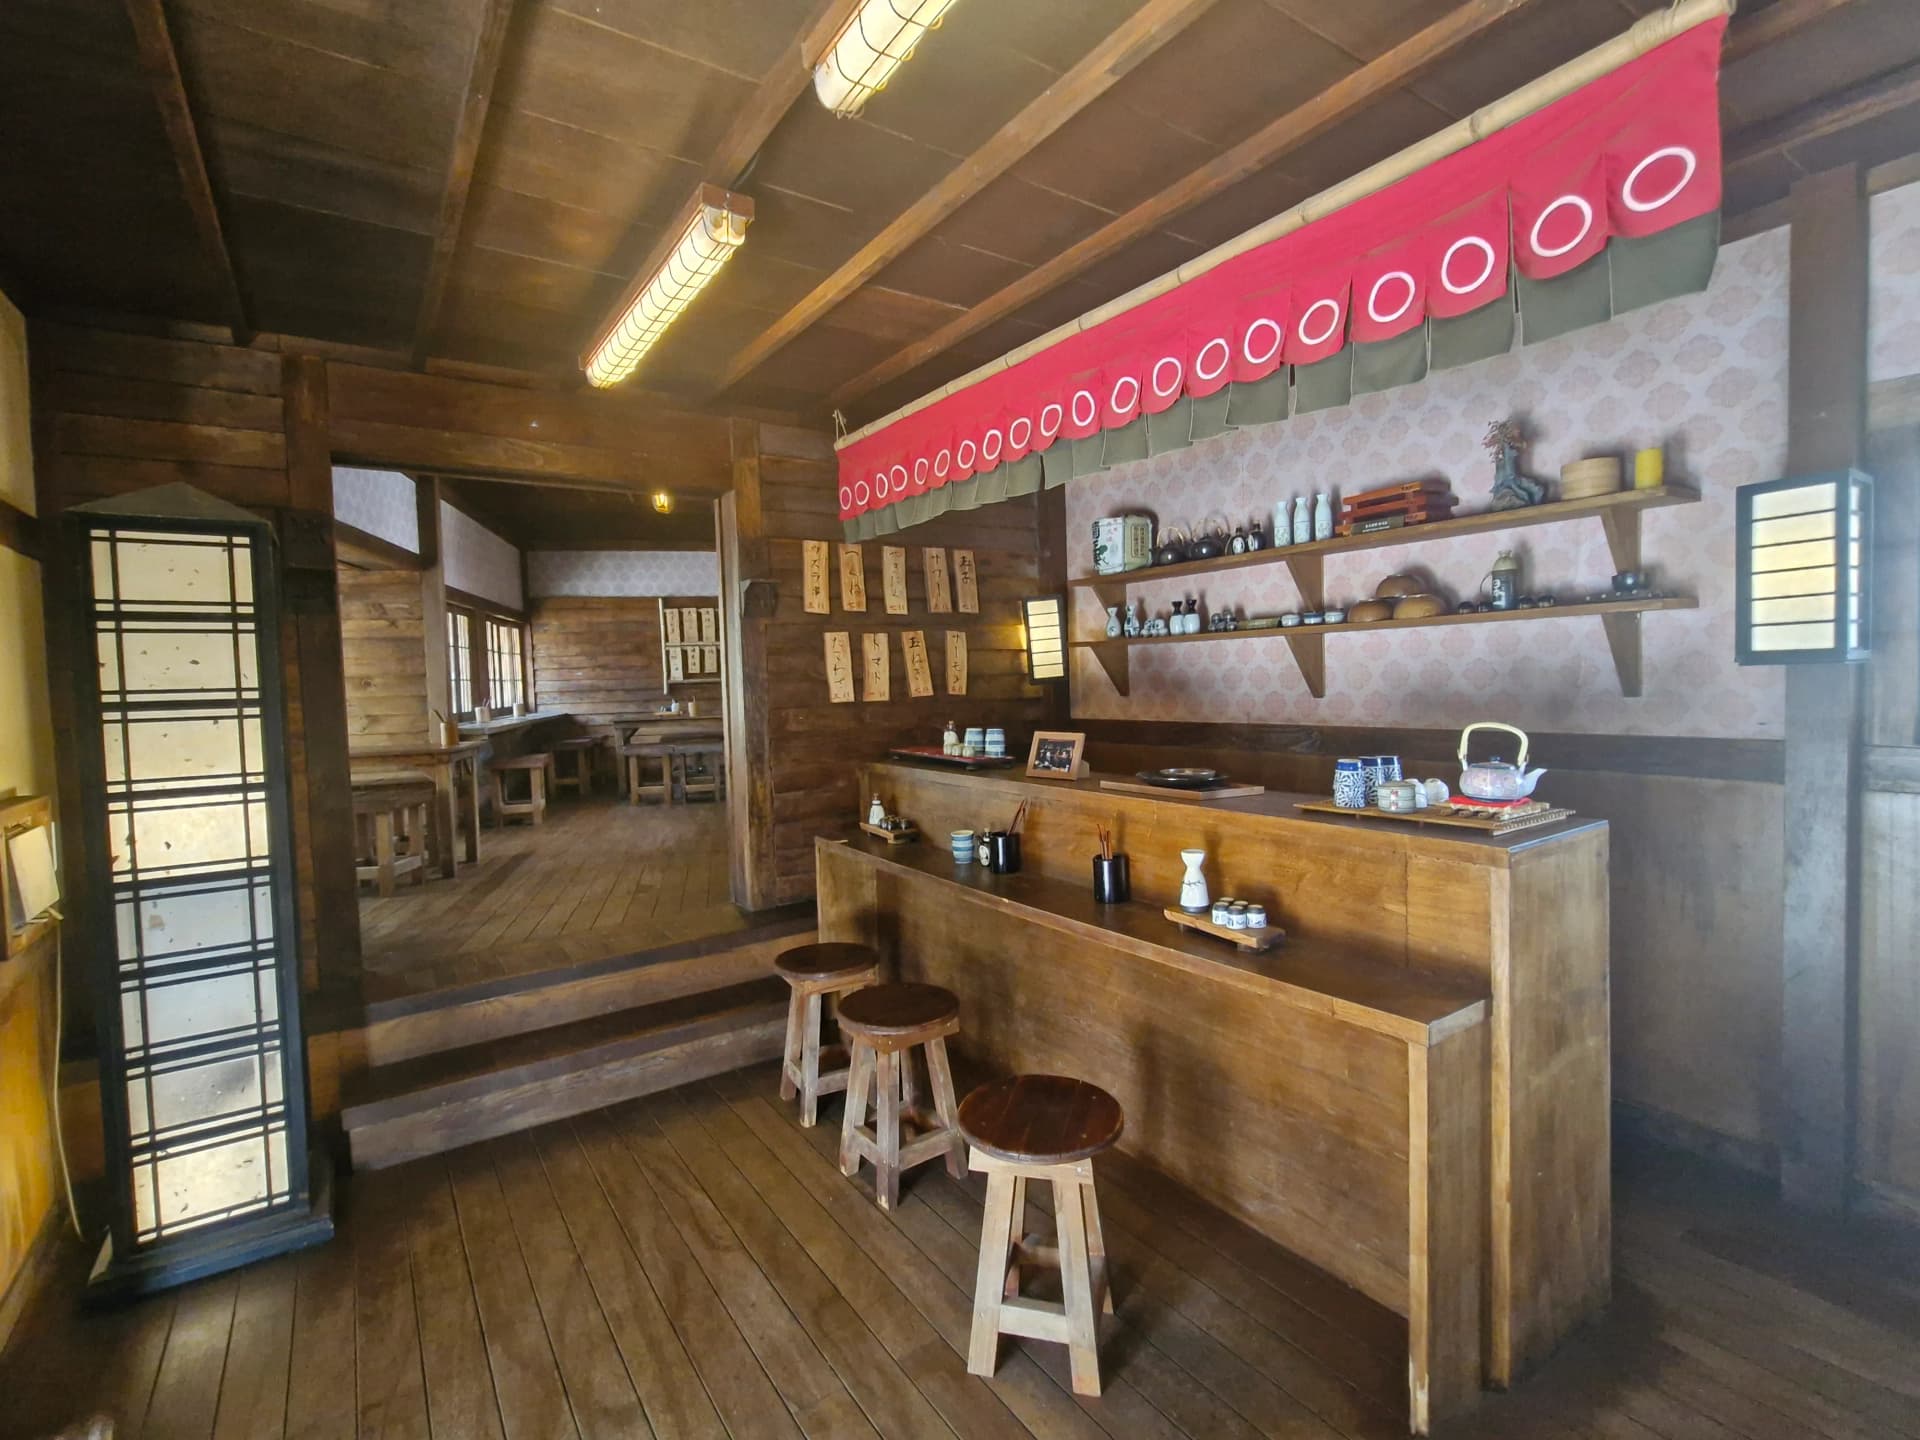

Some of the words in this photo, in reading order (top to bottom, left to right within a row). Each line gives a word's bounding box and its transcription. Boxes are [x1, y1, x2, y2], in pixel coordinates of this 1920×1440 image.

[845, 550, 862, 595] つくね
[870, 632, 881, 684] トマト
[951, 633, 961, 684] サーモン
